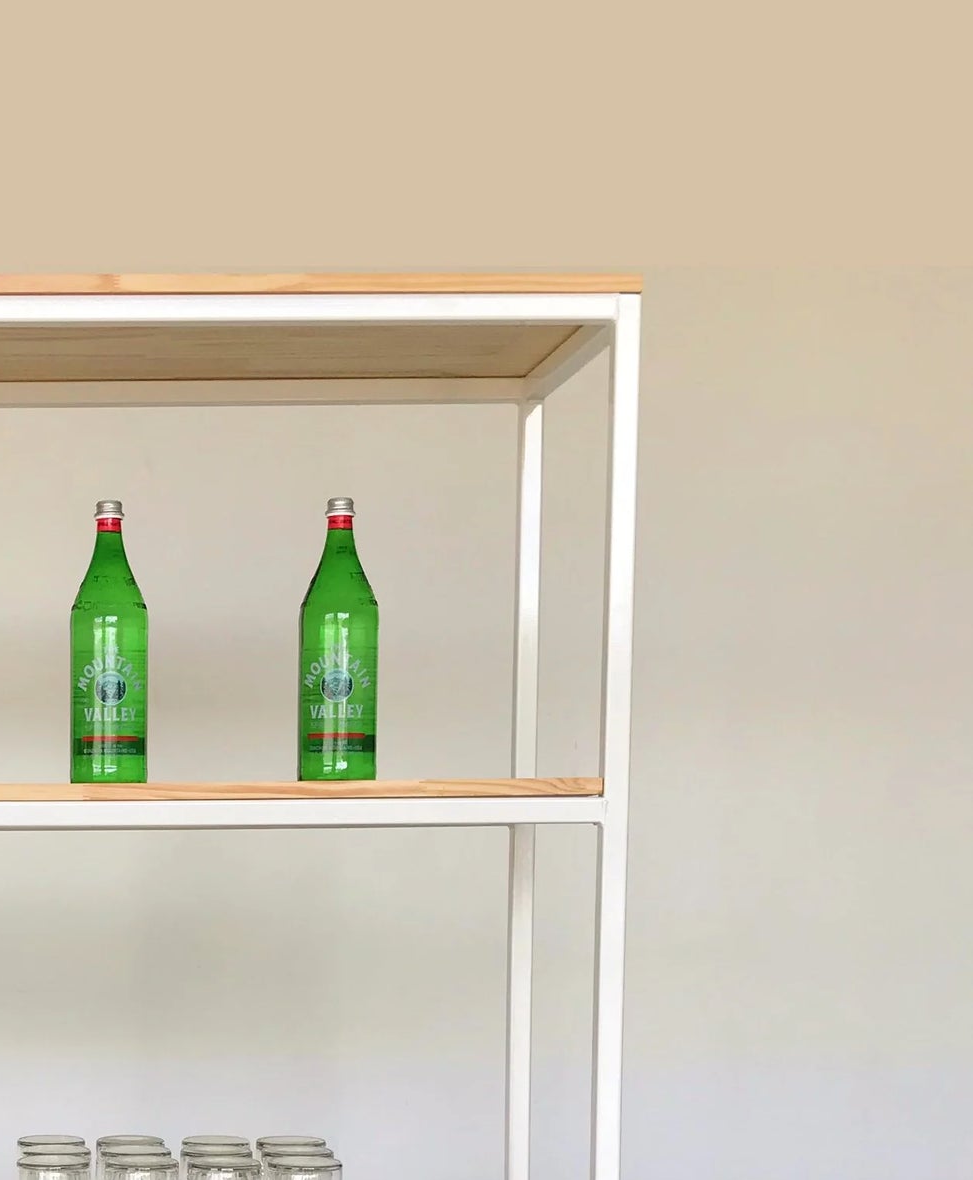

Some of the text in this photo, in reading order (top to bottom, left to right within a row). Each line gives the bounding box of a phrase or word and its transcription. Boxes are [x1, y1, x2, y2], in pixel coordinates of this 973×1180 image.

[77, 654, 142, 692] MOUNTAIN
[303, 653, 371, 689] MOUNTAIN
[84, 707, 137, 722] VALLEY
[310, 704, 364, 719] VALLEY
